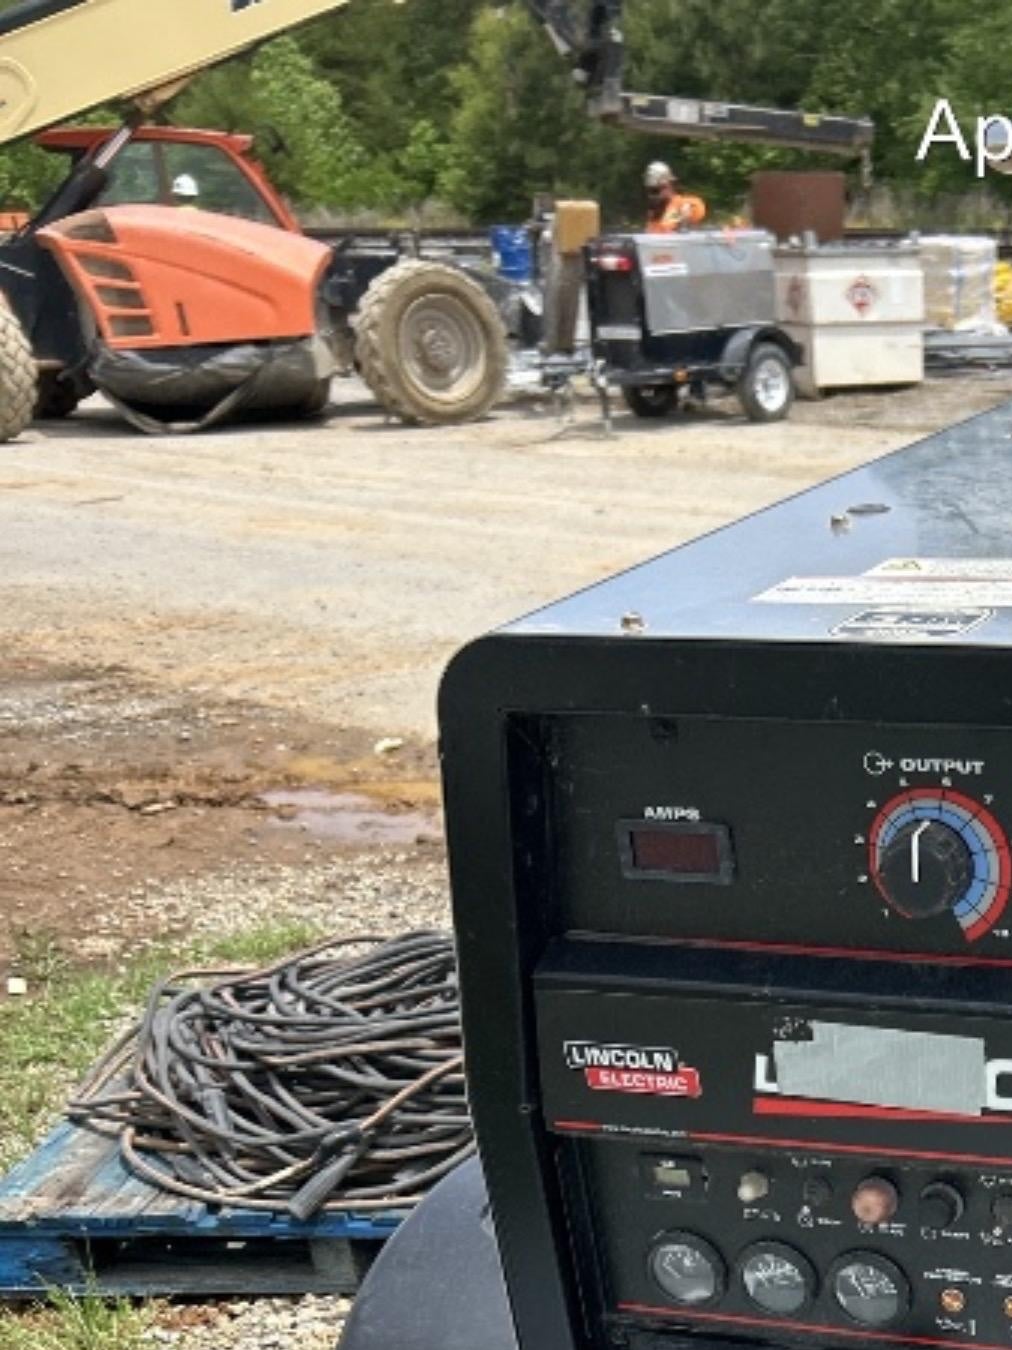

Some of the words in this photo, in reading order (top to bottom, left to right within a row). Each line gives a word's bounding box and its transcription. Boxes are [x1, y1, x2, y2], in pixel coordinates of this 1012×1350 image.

[900, 758, 985, 775] OUTPUT
[644, 806, 701, 821] AMPS
[572, 1047, 673, 1071] LINCOLN
[599, 1071, 688, 1091] ELECTRIC
